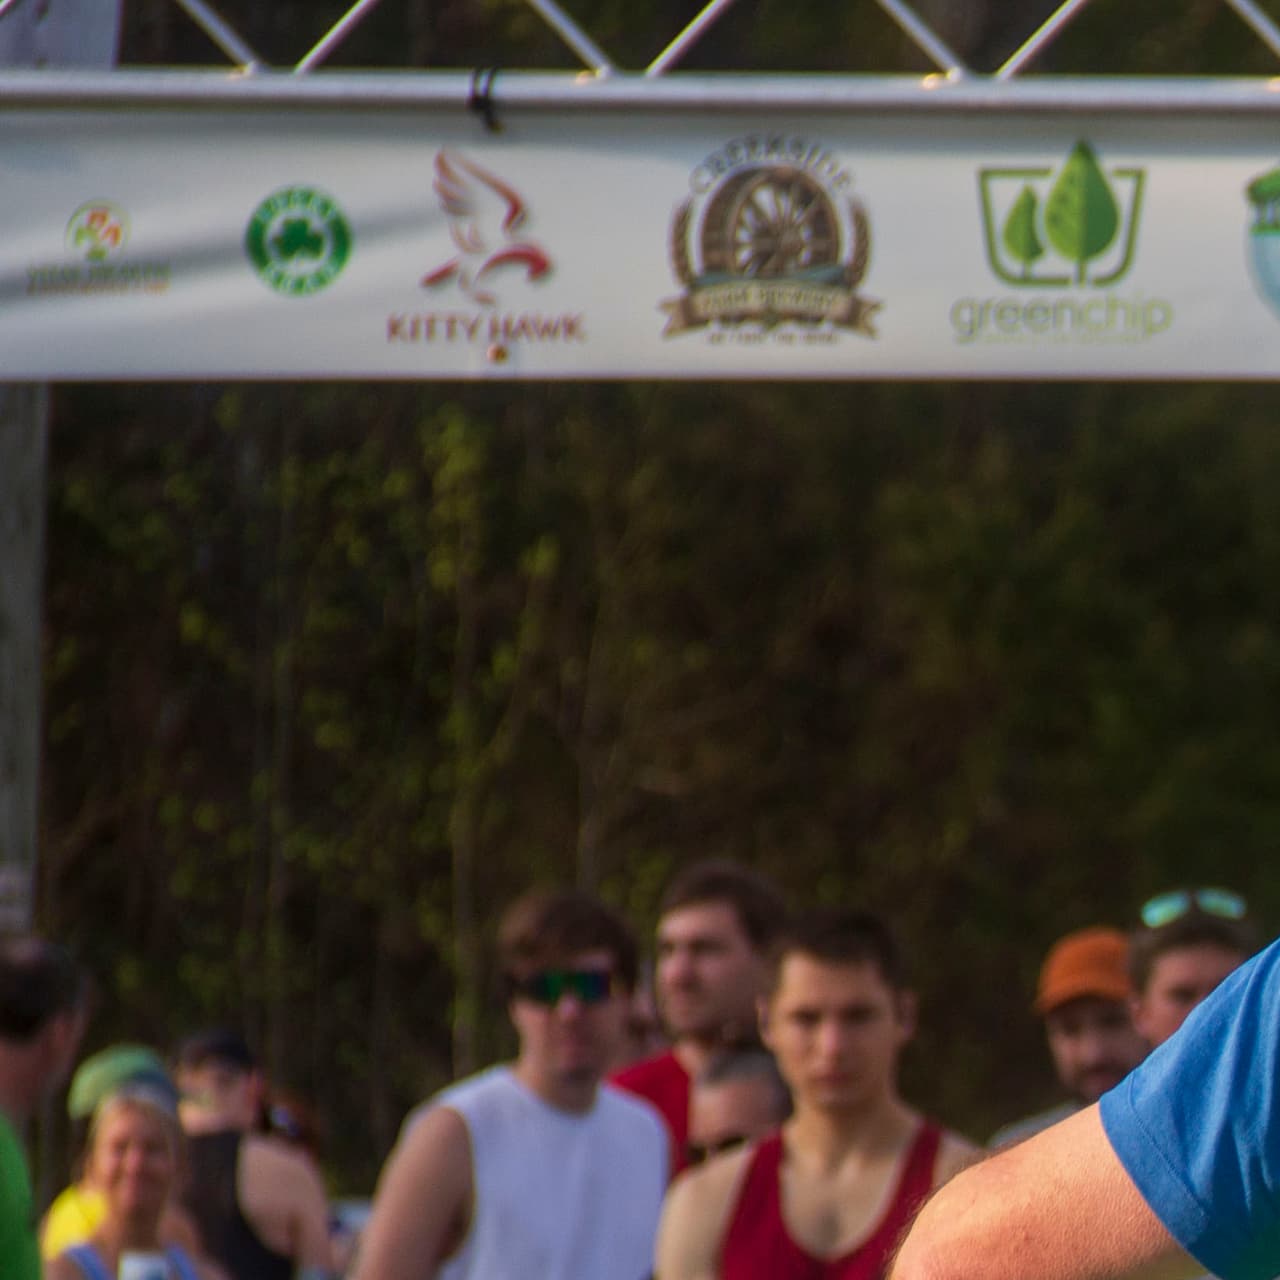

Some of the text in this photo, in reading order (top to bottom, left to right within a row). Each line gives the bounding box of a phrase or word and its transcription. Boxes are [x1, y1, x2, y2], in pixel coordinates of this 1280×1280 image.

[387, 313, 585, 344] KITTY HAWK
[950, 291, 1174, 344] greenchip
